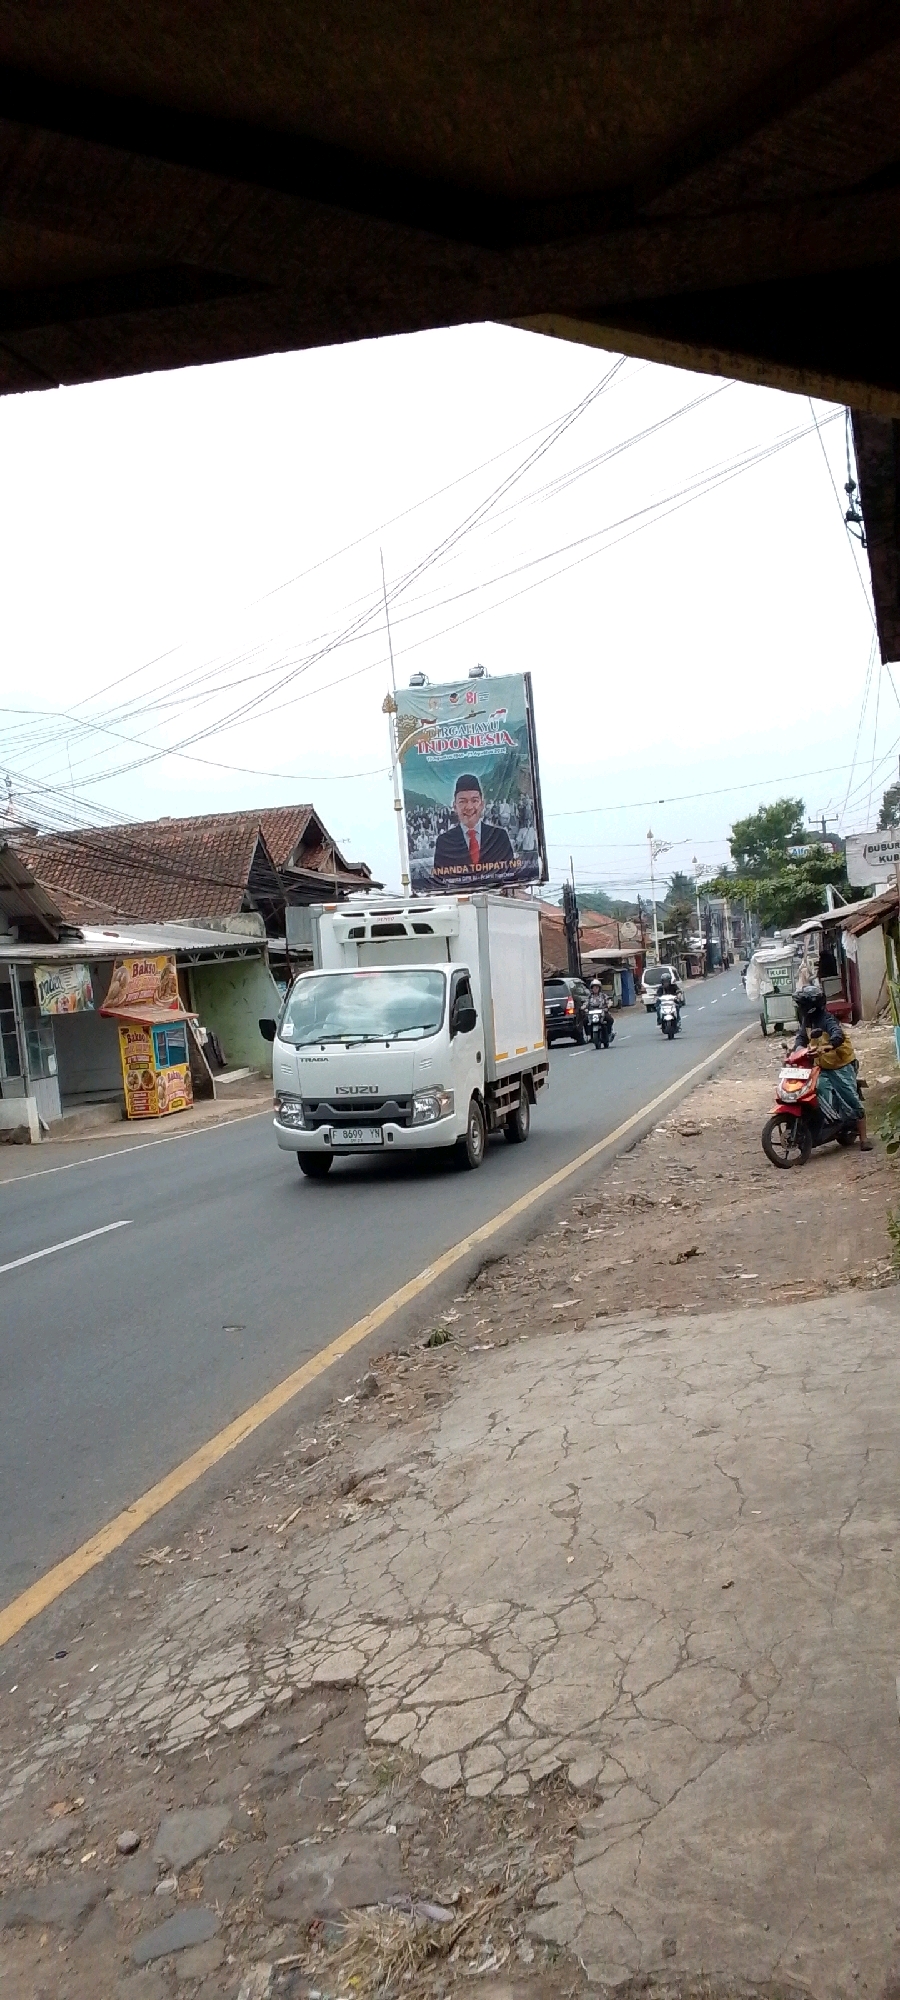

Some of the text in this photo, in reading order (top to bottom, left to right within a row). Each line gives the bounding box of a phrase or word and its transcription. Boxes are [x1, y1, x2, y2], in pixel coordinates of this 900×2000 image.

[416, 730, 518, 755] INDONESIA
[868, 842, 900, 853] BUBUR
[430, 864, 468, 876] ANANDA
[131, 960, 156, 978] Bakso
[335, 1085, 379, 1095] ISUZU
[332, 1131, 338, 1139] F
